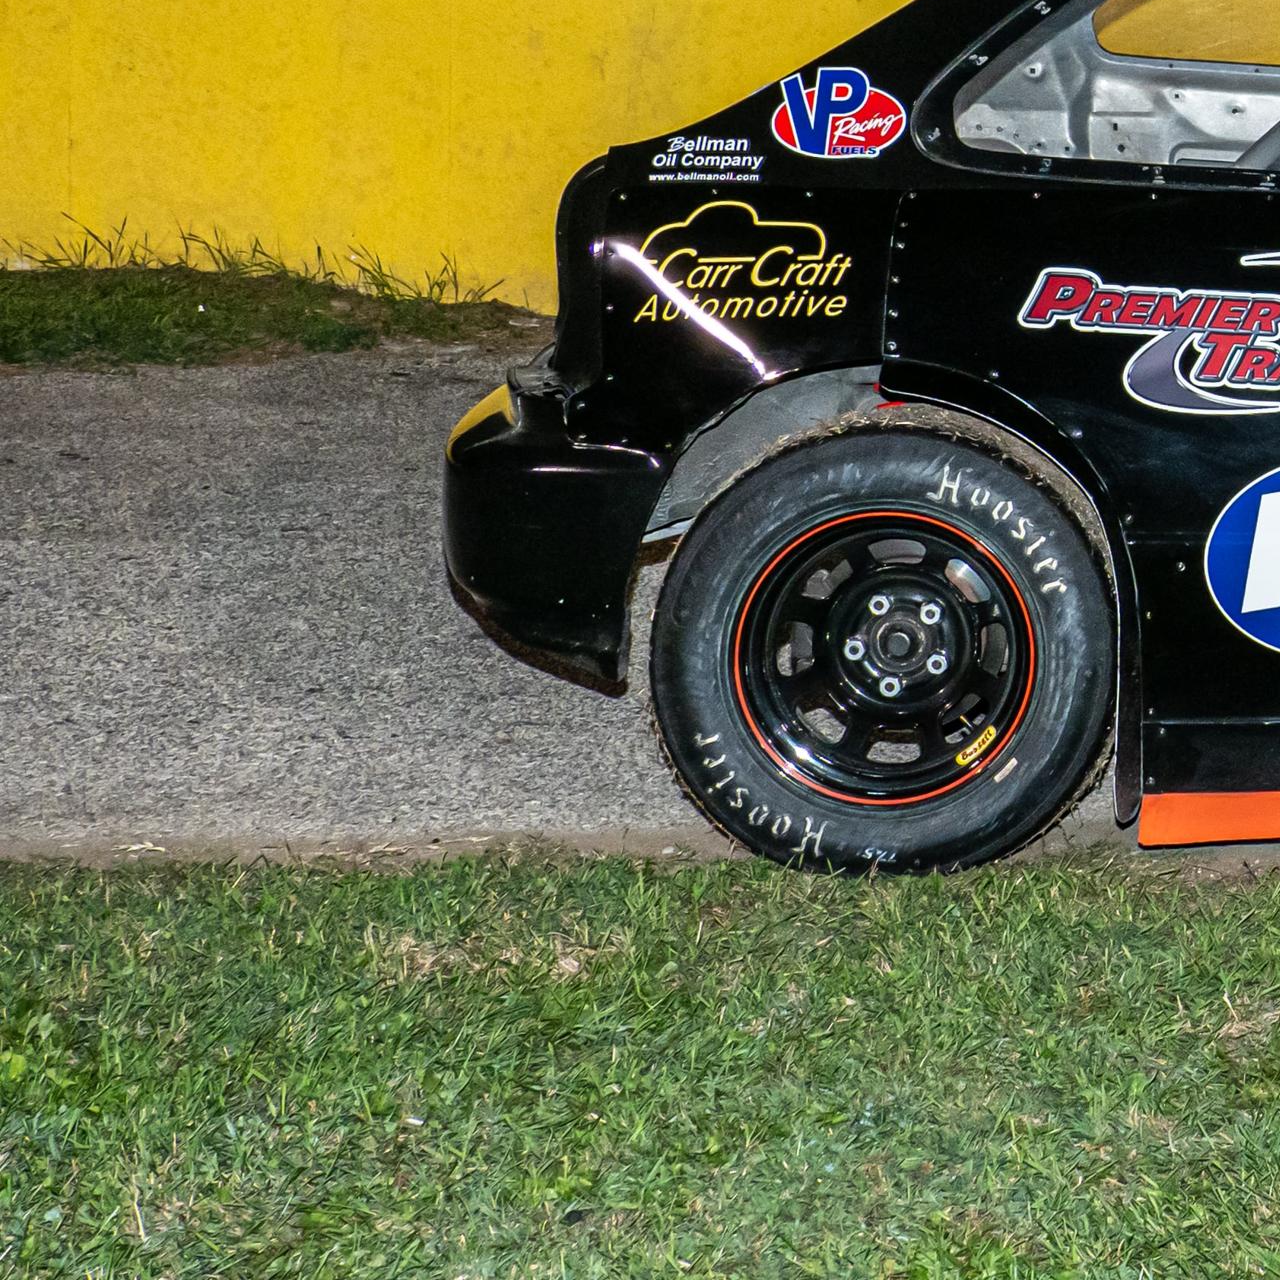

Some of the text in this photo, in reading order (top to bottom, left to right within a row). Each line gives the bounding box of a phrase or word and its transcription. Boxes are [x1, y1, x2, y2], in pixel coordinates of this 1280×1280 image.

[780, 67, 870, 156] VP
[667, 136, 749, 152] Bellman
[832, 113, 905, 145] Racing
[652, 154, 764, 169] Oil Company
[831, 146, 878, 155] FUELS
[657, 245, 852, 288] Carr Craft
[634, 290, 848, 323] Automotive
[926, 463, 1068, 595] Hoosier
